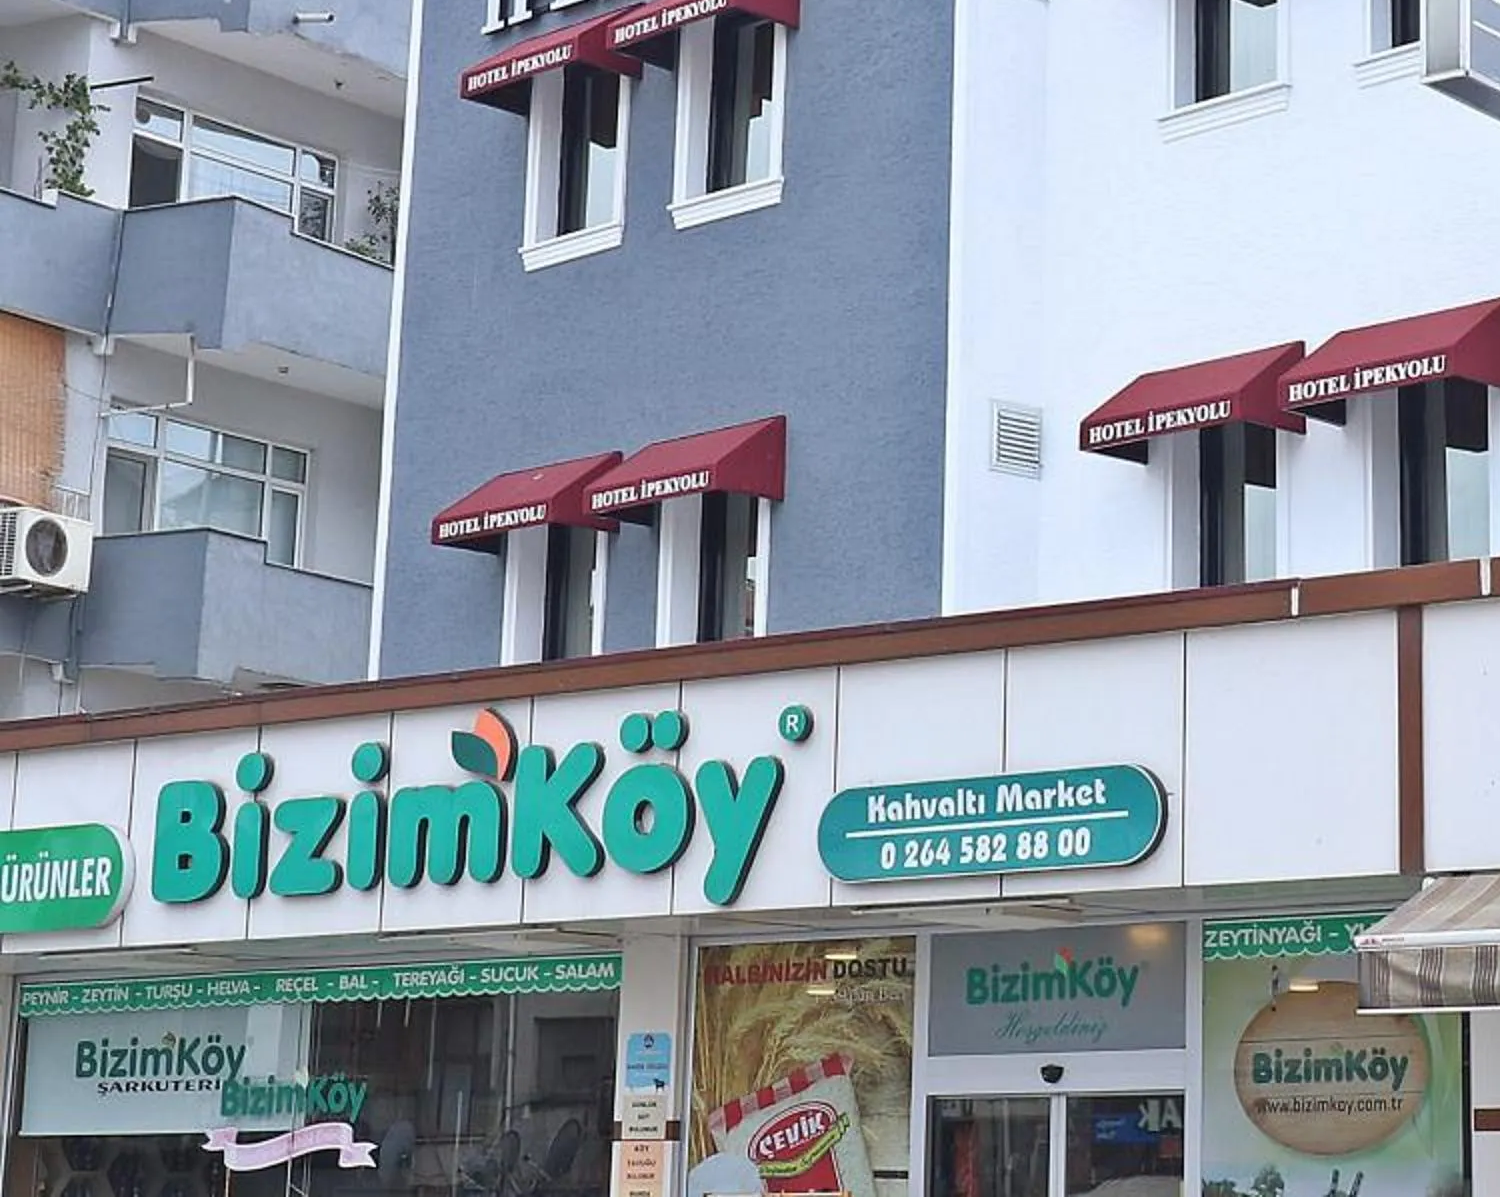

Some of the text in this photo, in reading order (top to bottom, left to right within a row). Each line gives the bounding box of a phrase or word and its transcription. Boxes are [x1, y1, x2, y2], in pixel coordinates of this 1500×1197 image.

[614, 17, 658, 45] HOTEL
[467, 44, 573, 92] HOTEL İPEKYOLU
[1288, 354, 1447, 402] HOTEL İPEKYOLU
[1088, 400, 1232, 445] HOTEL İPEKYOLU
[591, 470, 710, 510] HOTEL İPEKYOLU
[439, 504, 547, 539] HOTEL İPEKYOLU
[867, 778, 1106, 824] Kahvaltı Market
[880, 827, 1091, 870] 0 264 582 88 00
[1, 850, 111, 903] ÜRÜNLER
[1205, 920, 1322, 949] ZEYTİNYAĞI
[22, 986, 69, 1005] PEYNİR
[82, 982, 129, 1003] ZEYTİN
[145, 984, 193, 1002] TURŞU
[207, 979, 250, 996] HELVA
[339, 975, 369, 991] BAL
[393, 964, 465, 988] TEREYAĞI
[480, 966, 539, 984] SUCUK
[555, 962, 615, 981] SALAM
[965, 956, 1139, 1008] BizimKöy
[75, 1034, 246, 1085] BizimKöy
[1252, 1047, 1409, 1092] BizimKöy
